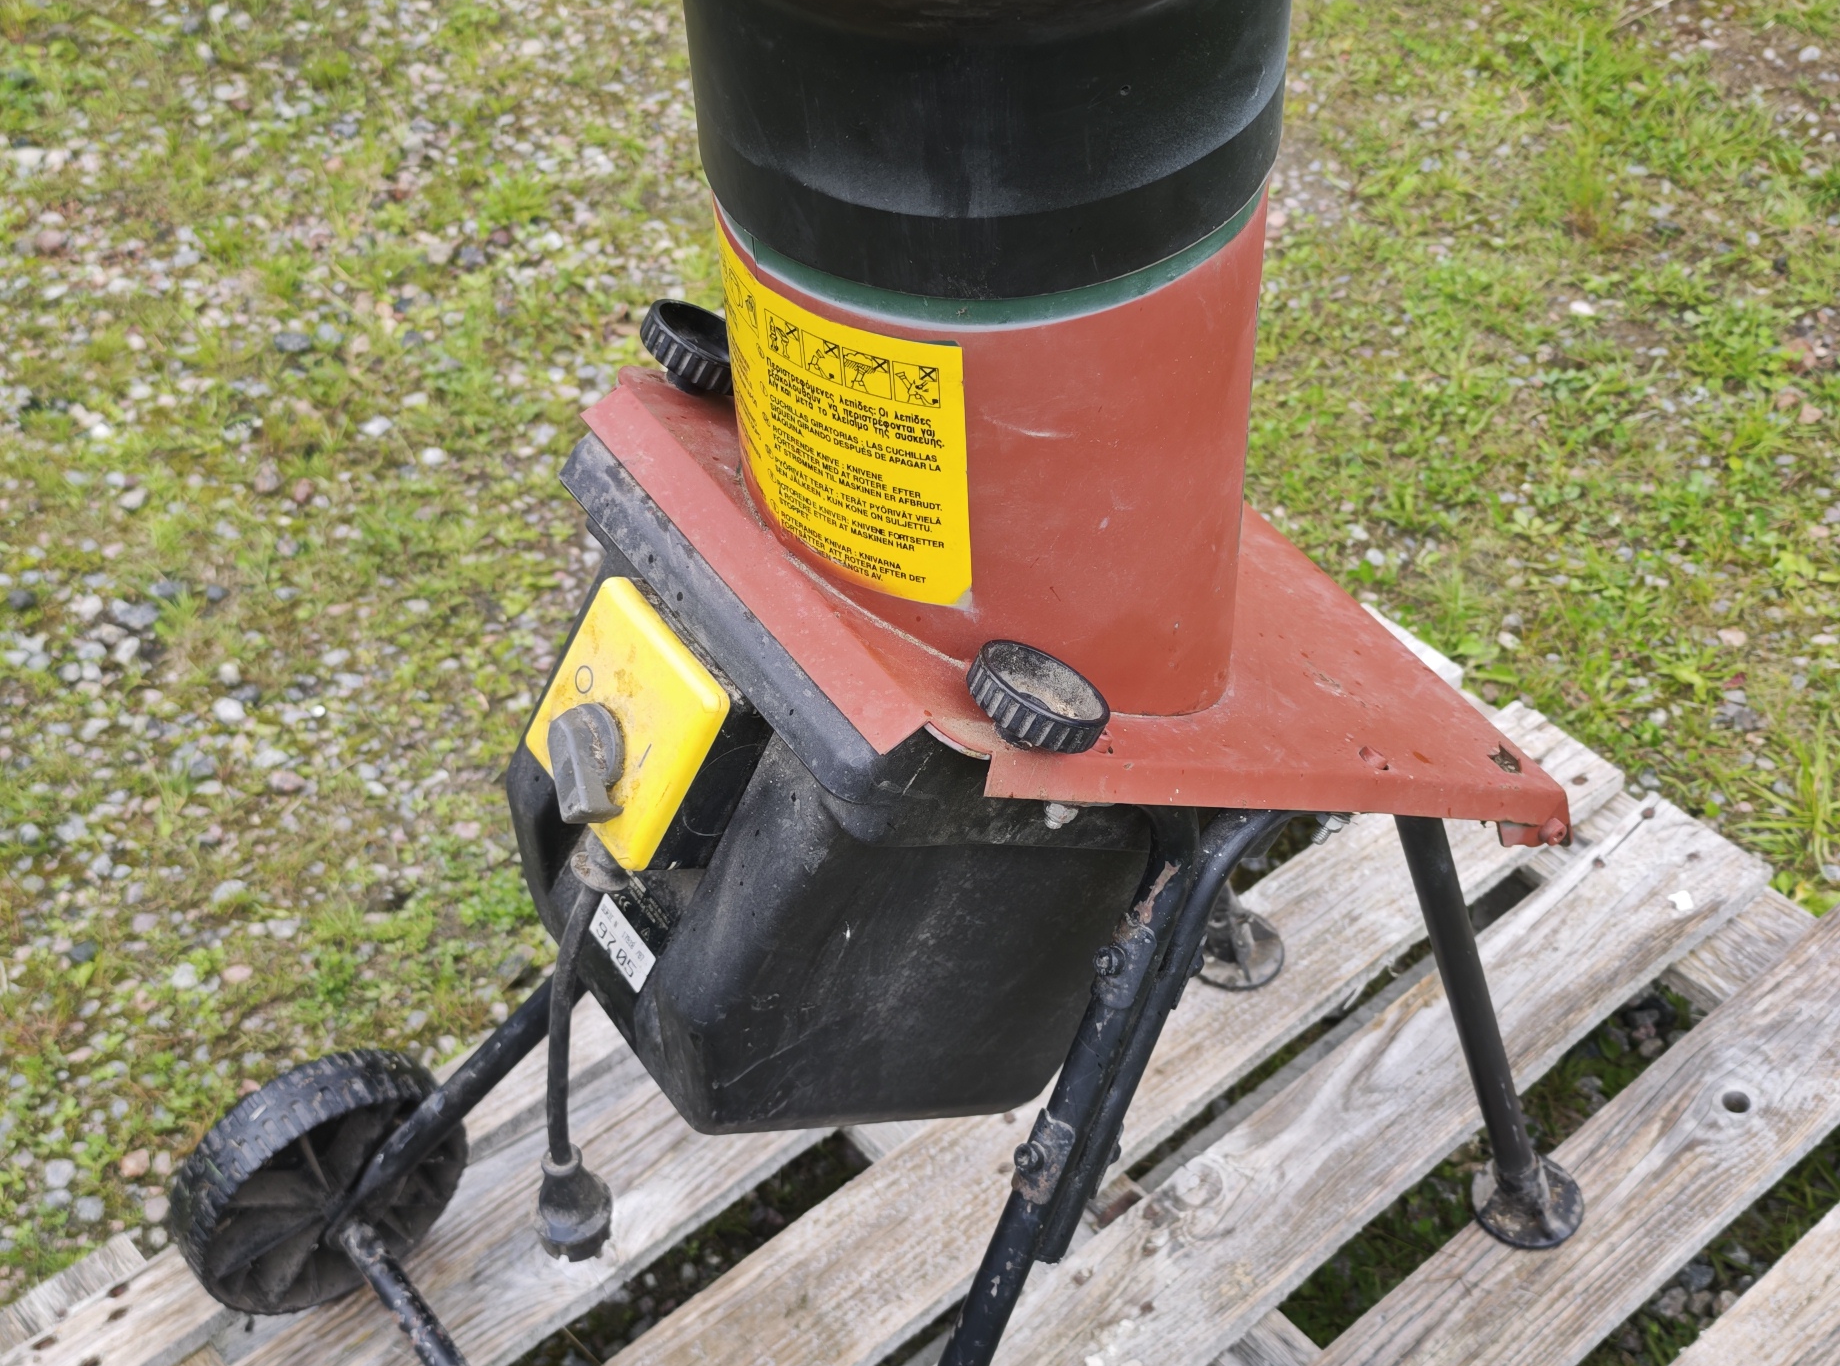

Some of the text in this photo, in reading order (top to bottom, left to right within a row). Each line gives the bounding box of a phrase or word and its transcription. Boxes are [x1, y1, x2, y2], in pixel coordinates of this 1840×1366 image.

[770, 394, 808, 423] CUCHILLAS
[810, 419, 858, 444] GIRATORIAS
[866, 440, 883, 451] LAS
[885, 446, 938, 463] CUCHILLAS
[770, 402, 796, 423] SIGUEN
[797, 419, 831, 442] GIRANDO
[833, 438, 872, 457] DESPUÉS
[875, 451, 886, 461] DE
[889, 455, 926, 470] APAGAR
[929, 463, 941, 472] LA
[773, 425, 815, 455] ROTERENDE
[817, 450, 840, 467] KNIVE
[846, 463, 883, 482] KNIVENE
[774, 443, 781, 452] AT
[825, 471, 837, 483] TIL
[839, 478, 882, 498] MASKINEN
[884, 493, 896, 502] ER
[898, 496, 942, 511] AFBRUDT.
[822, 462, 839, 475] MED
[841, 470, 850, 479] AT
[853, 474, 887, 492] ROTERE
[892, 486, 921, 499] EFTER
[781, 510, 823, 541] ROTERANDE
[824, 536, 852, 555] KNIVAR
[859, 551, 901, 571] KNIVARNA
[784, 492, 812, 515] ROTERE
[813, 509, 838, 528] ETTER
[839, 523, 848, 532] AT
[850, 526, 894, 547] MASKINEN
[896, 540, 915, 552] HAR
[827, 495, 843, 508] KUN
[846, 502, 868, 517] KONE
[871, 512, 883, 522] ON
[885, 516, 932, 533] SULJETTU.
[851, 519, 887, 537] KNIVENE
[888, 530, 945, 549] FORTSETTER
[829, 547, 843, 558] ATT
[844, 553, 877, 572] ROTERA
[879, 566, 907, 580] EFTER
[909, 573, 926, 584] DET
[871, 571, 883, 582] AV.
